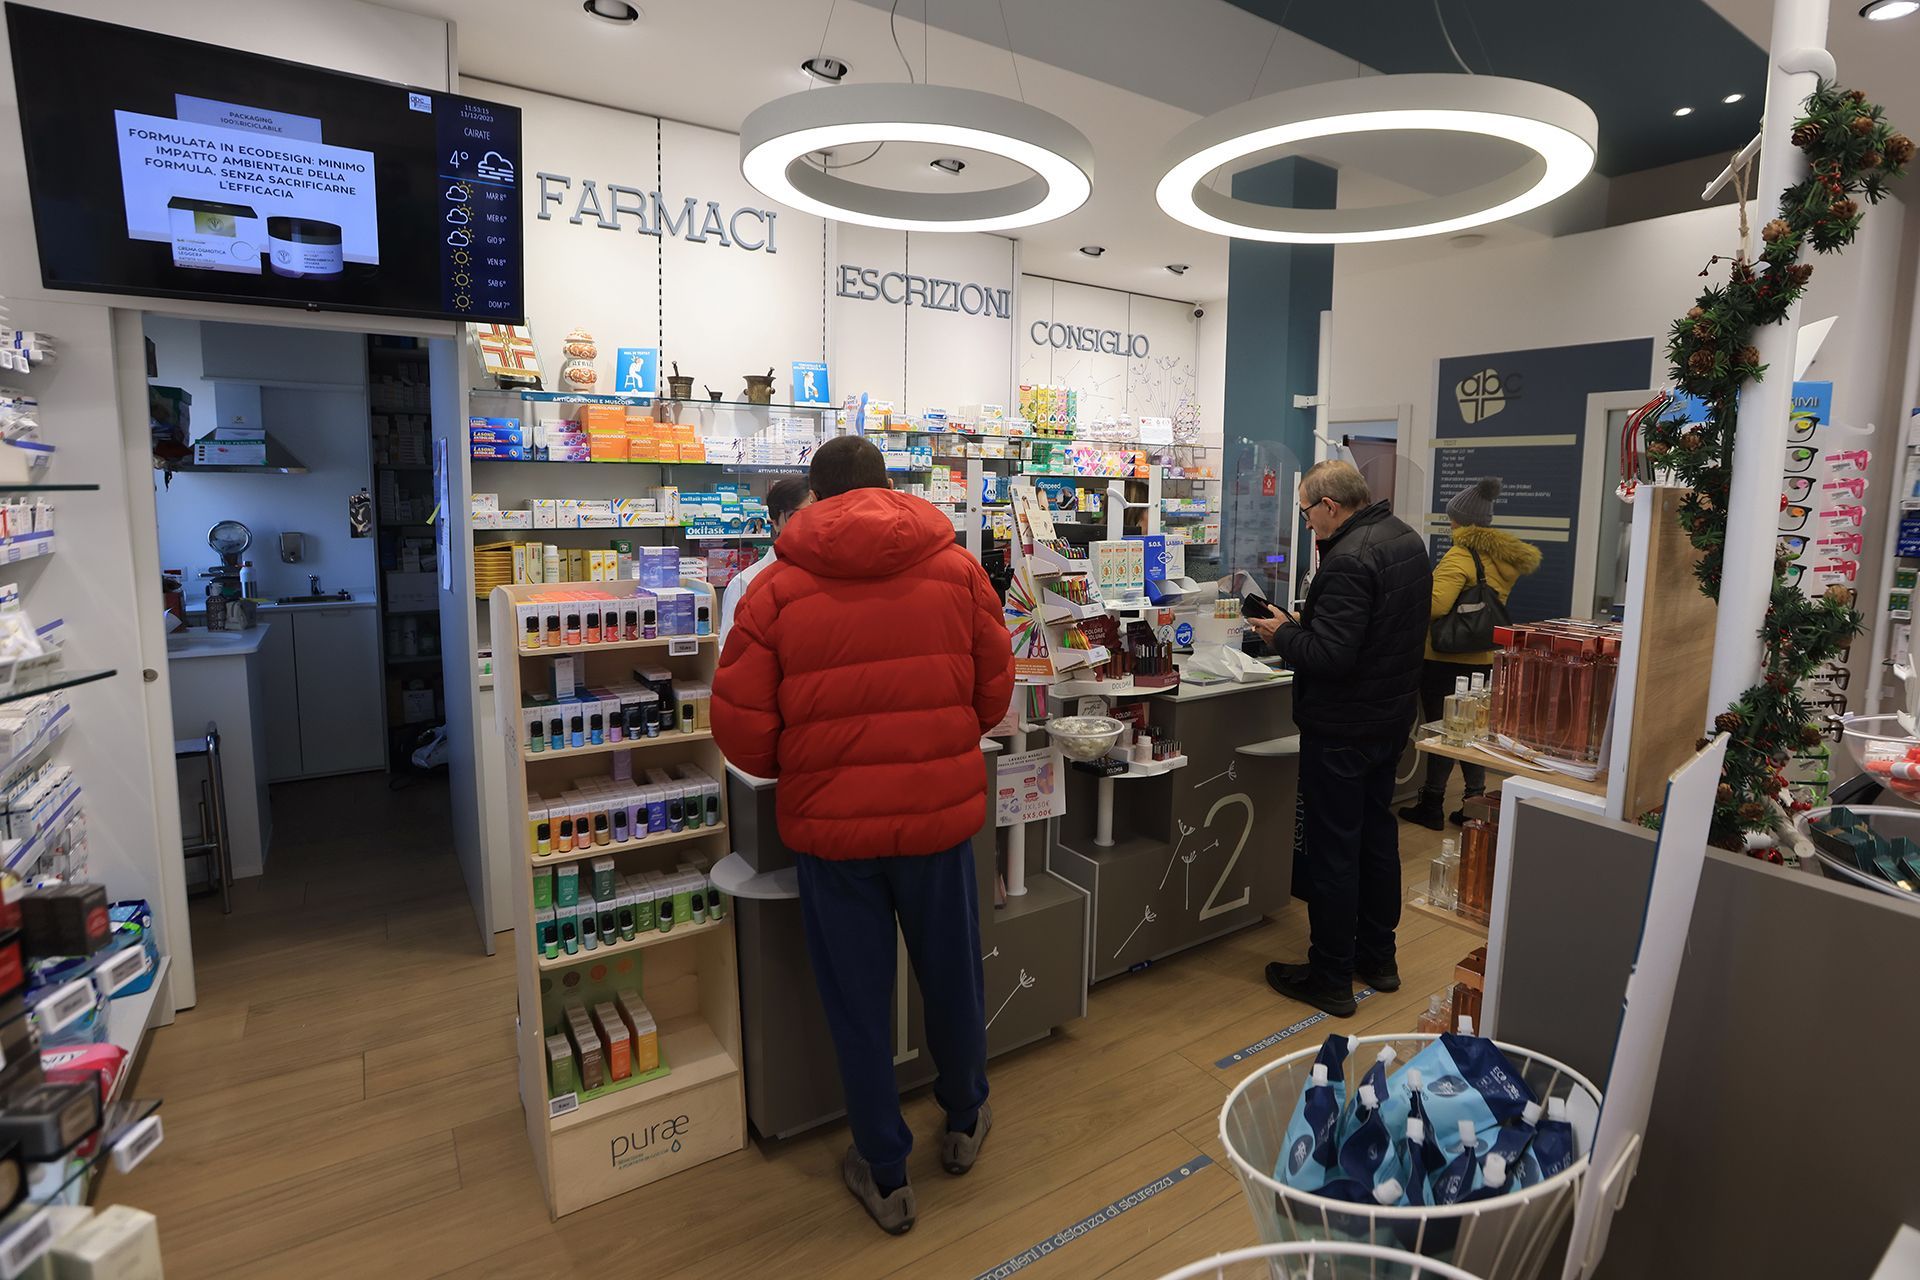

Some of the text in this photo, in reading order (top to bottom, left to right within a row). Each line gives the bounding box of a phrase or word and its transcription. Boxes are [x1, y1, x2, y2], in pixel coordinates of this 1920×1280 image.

[229, 111, 273, 124] PACKAGING
[460, 111, 494, 122] 11/12/2023
[464, 128, 490, 140] CAIRATE
[129, 128, 366, 174] FORMULATA IN ECODESIGN: MINIMO
[450, 150, 468, 168] 4°
[156, 146, 346, 183] IMPATTO AMBIENTALE DELLA
[219, 181, 294, 199] L'EFFICACIA
[221, 168, 264, 183] SENZA
[269, 175, 357, 196] SACRIFICARNE
[486, 192, 500, 200] MAR
[486, 214, 500, 222] MER
[536, 172, 777, 254] FARMACI
[487, 258, 499, 266] VEN
[836, 264, 1011, 320] ESCRIZIONI
[1030, 320, 1150, 359] CONSIGLIO
[1794, 396, 1819, 407] IMI
[1200, 793, 1254, 921] 2
[1246, 1033, 1281, 1055] mantieni
[1288, 1016, 1321, 1034] distanza
[1039, 1241, 1054, 1255] la
[1054, 1213, 1107, 1247] distanza
[1106, 1206, 1120, 1218] di
[1119, 1176, 1174, 1210] sicurezza
